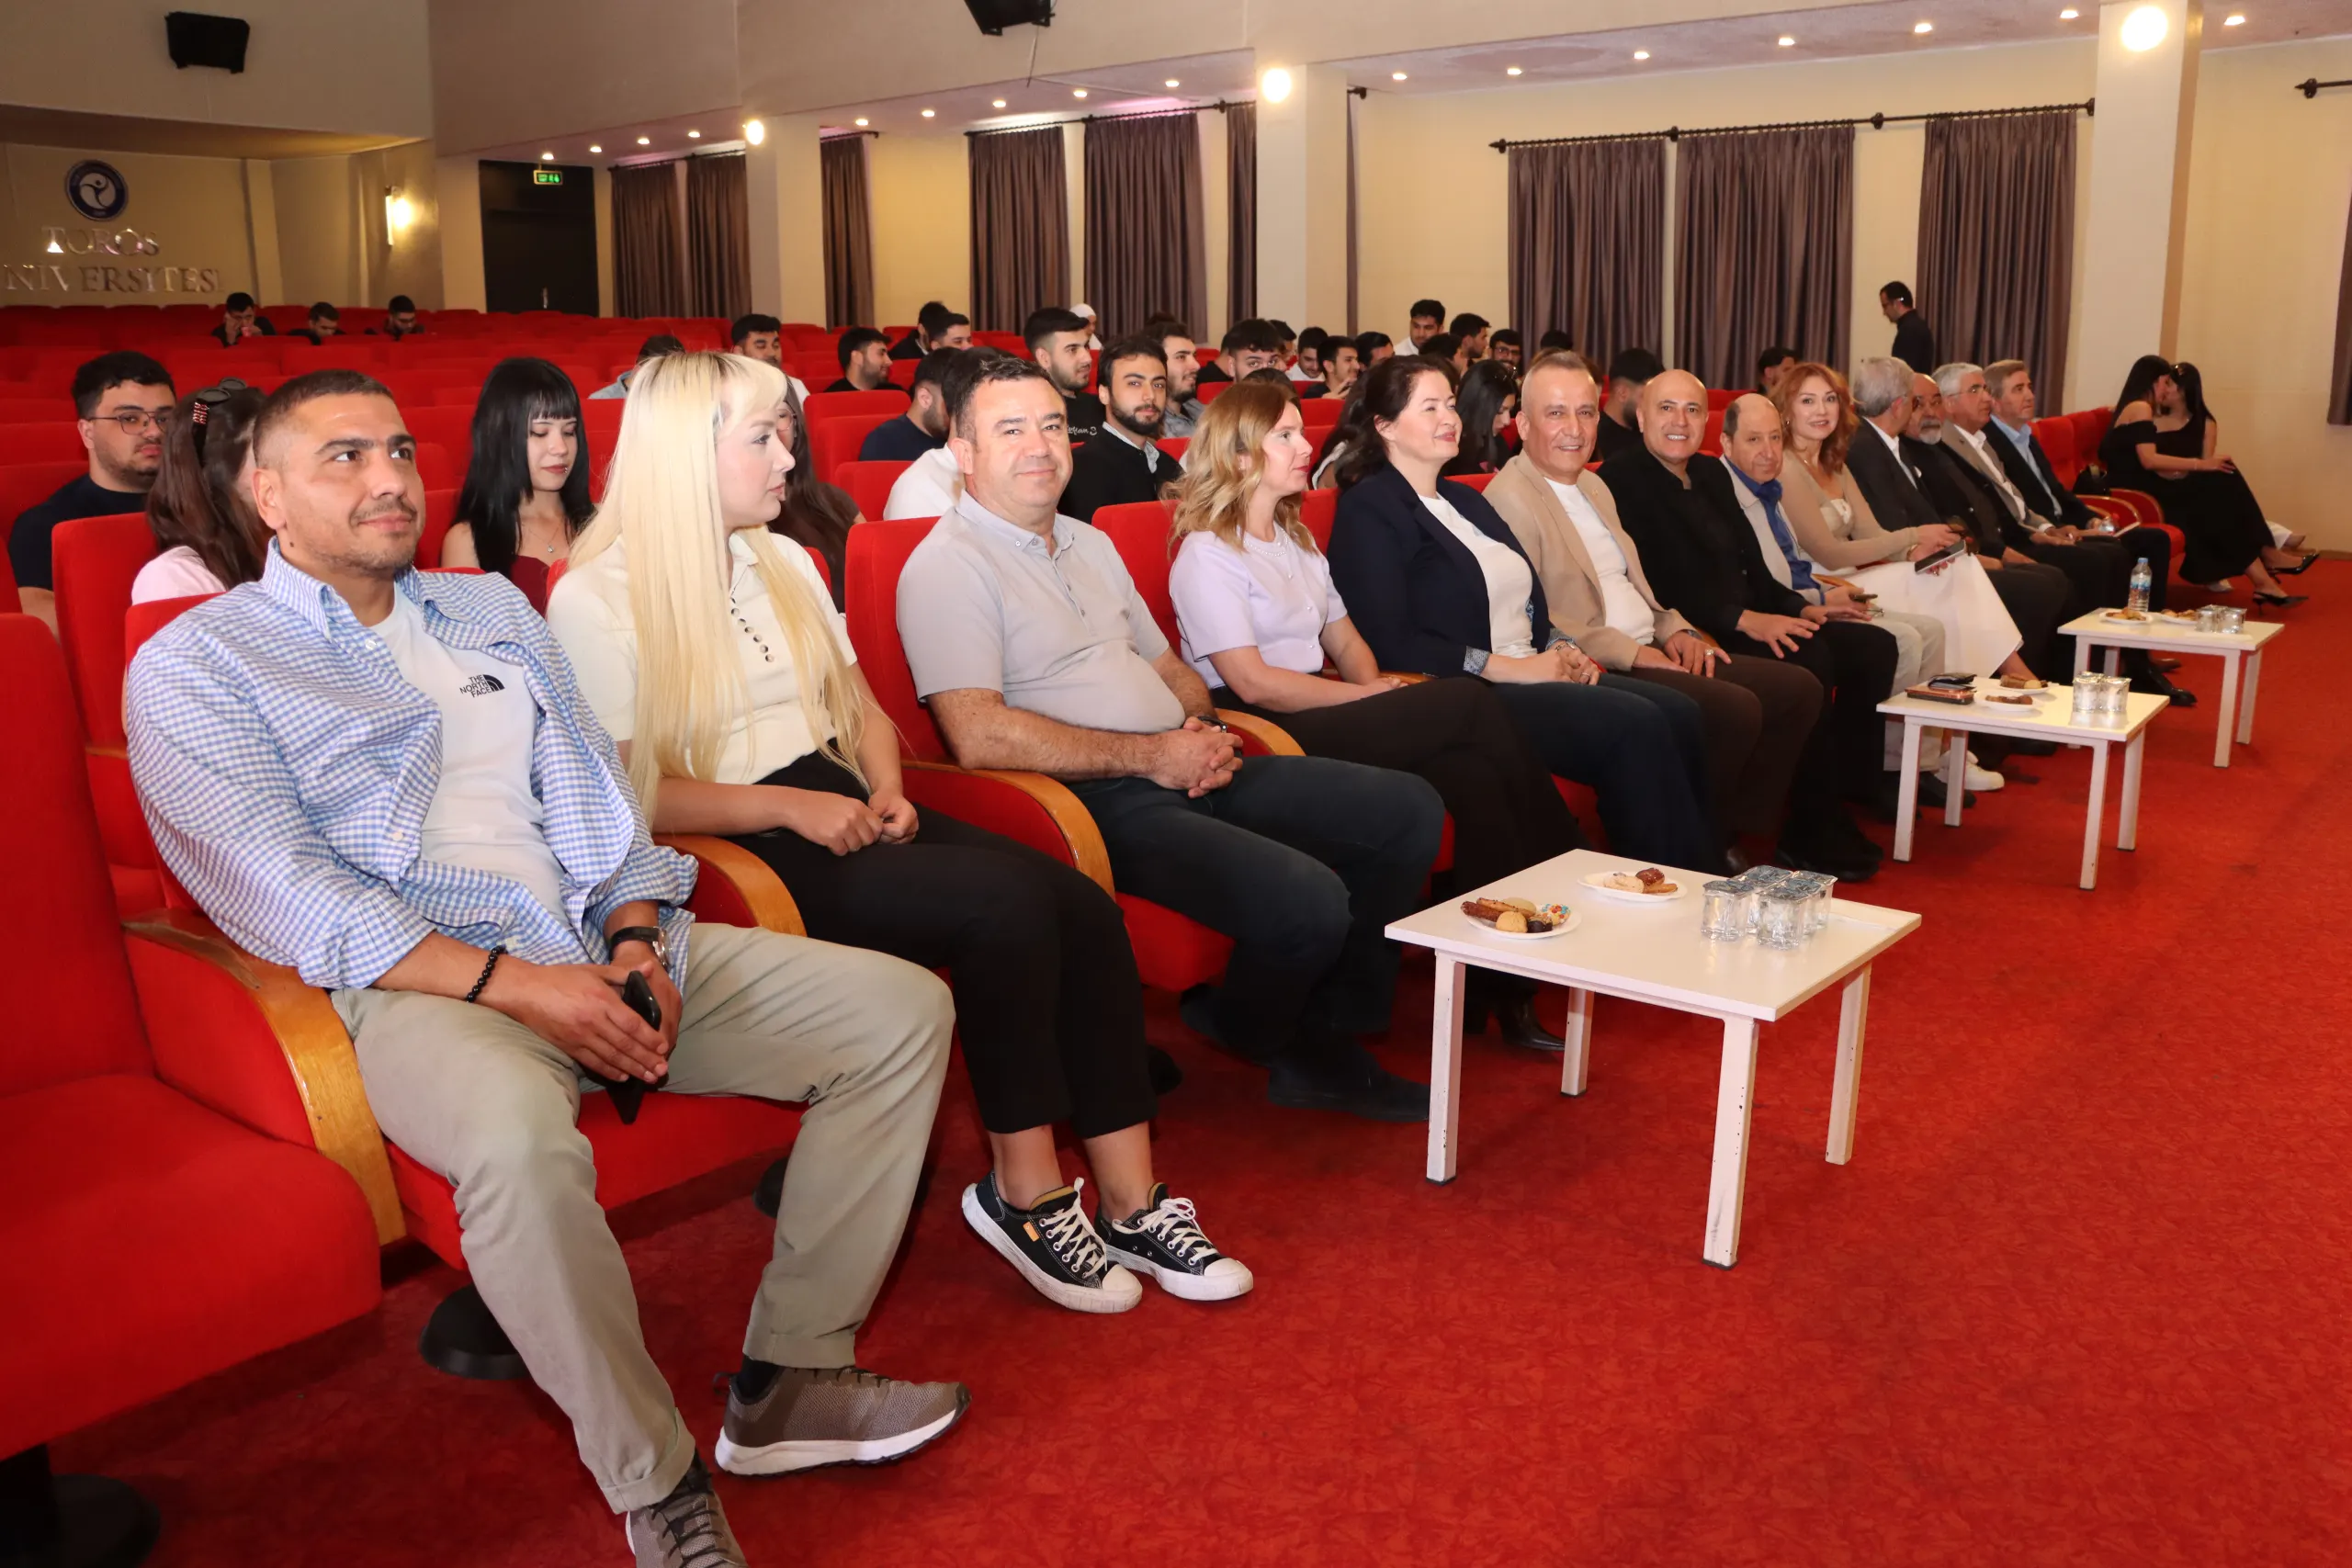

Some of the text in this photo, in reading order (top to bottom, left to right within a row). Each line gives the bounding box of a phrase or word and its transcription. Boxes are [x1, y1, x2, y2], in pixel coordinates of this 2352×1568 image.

[42, 226, 159, 255] TOROS
[469, 674, 484, 683] THE
[459, 680, 489, 694] NORTH
[470, 687, 492, 698] FACE
